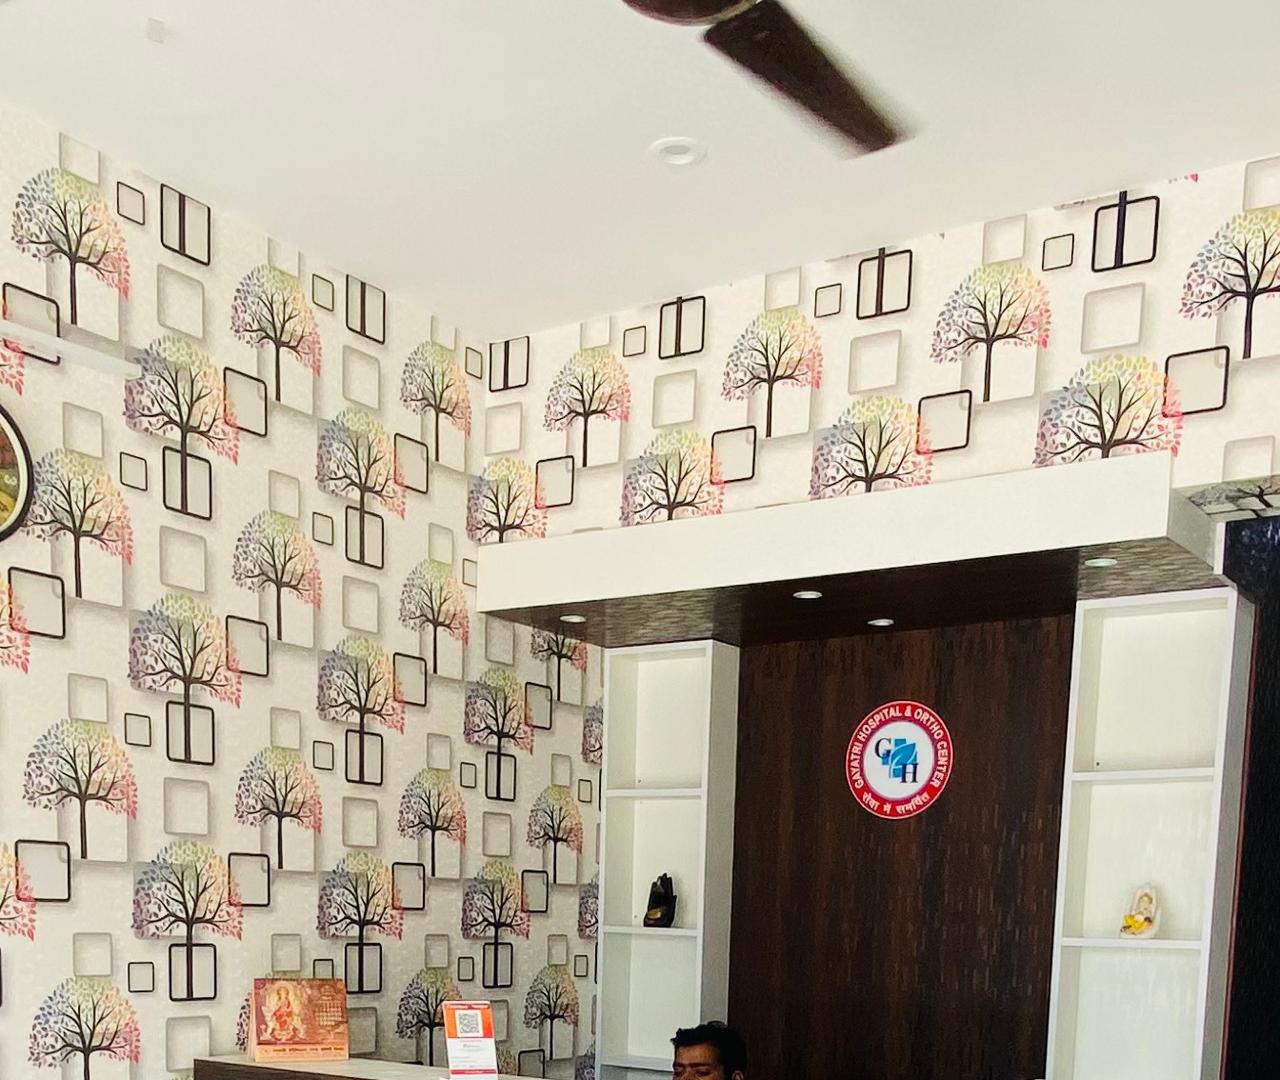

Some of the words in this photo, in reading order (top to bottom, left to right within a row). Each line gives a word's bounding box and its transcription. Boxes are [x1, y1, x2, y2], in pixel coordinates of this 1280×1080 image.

[3, 474, 18, 487] 3
[850, 742, 864, 789] GAYATRI
[857, 705, 902, 742] HOSPITAL
[904, 705, 912, 717] &
[914, 708, 944, 740] ORTHO
[930, 741, 949, 788] CENTER
[874, 737, 892, 759] G
[899, 762, 919, 784] H
[862, 791, 880, 811] सेवा
[882, 802, 892, 815] में
